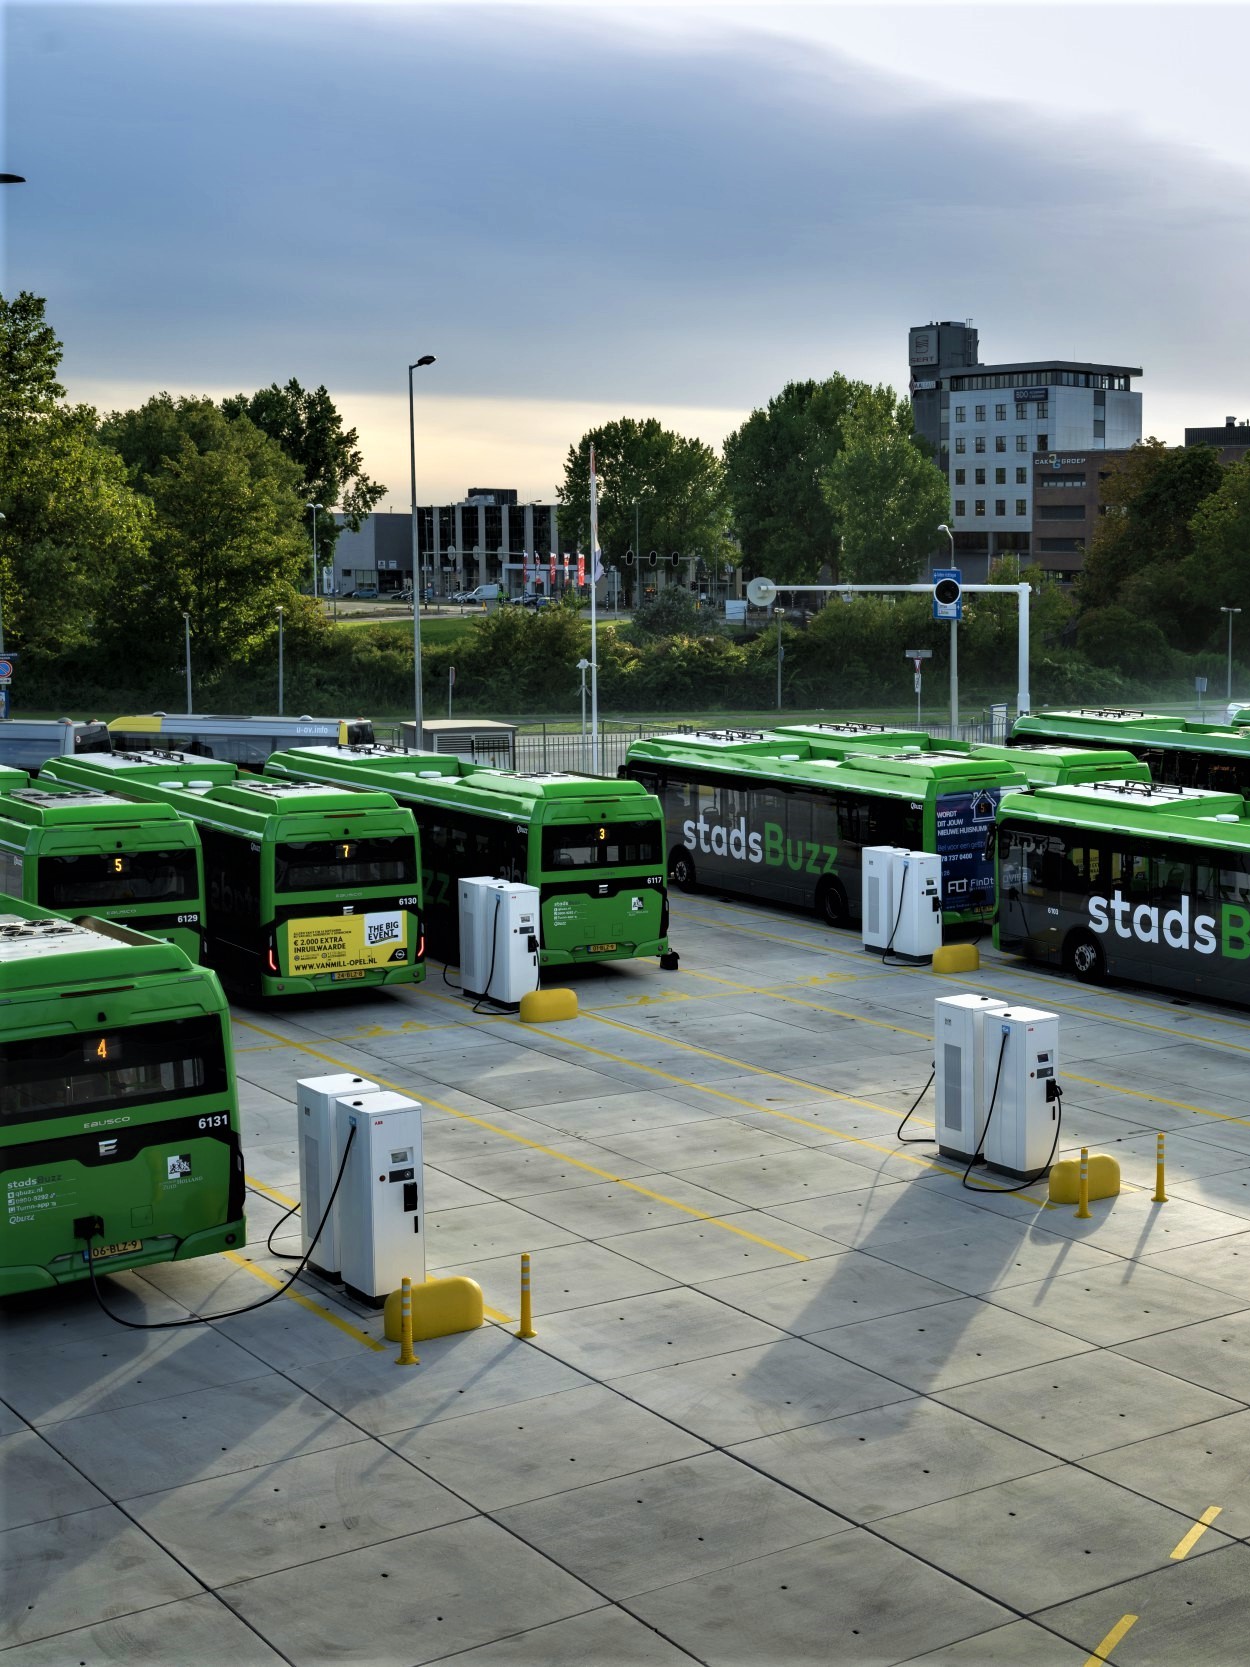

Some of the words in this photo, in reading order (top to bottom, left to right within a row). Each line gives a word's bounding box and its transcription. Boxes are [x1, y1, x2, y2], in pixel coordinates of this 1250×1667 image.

[296, 726, 328, 734] u-ov.info
[936, 810, 957, 819] WORDT
[937, 820, 946, 828] DIT
[947, 819, 964, 827] JOUW
[599, 828, 605, 839] 3
[937, 827, 959, 837] NIEUWE
[683, 814, 839, 876] stadsBuzz
[342, 845, 349, 858] 7
[115, 858, 122, 872] 5
[647, 876, 662, 884] 6117
[398, 897, 418, 906] 6130
[1047, 906, 1059, 915] 6103
[177, 914, 198, 924] 6129
[368, 924, 384, 934] THE
[385, 921, 399, 930] BIG
[368, 928, 395, 941] EVENT
[300, 938, 319, 946] 2.000
[320, 936, 344, 944] EXTRA
[294, 942, 347, 954] INRUILWAARDE
[294, 957, 378, 971] WWW.VANMILL-OPEL.NL
[97, 1039, 107, 1058] 4
[83, 1116, 131, 1129] EBUSCO
[198, 1114, 228, 1129] 6131
[15, 1186, 43, 1197] qbuzz.nl
[9, 1214, 35, 1225] Qbuzz
[92, 1240, 138, 1258] 06-BLZ-9
